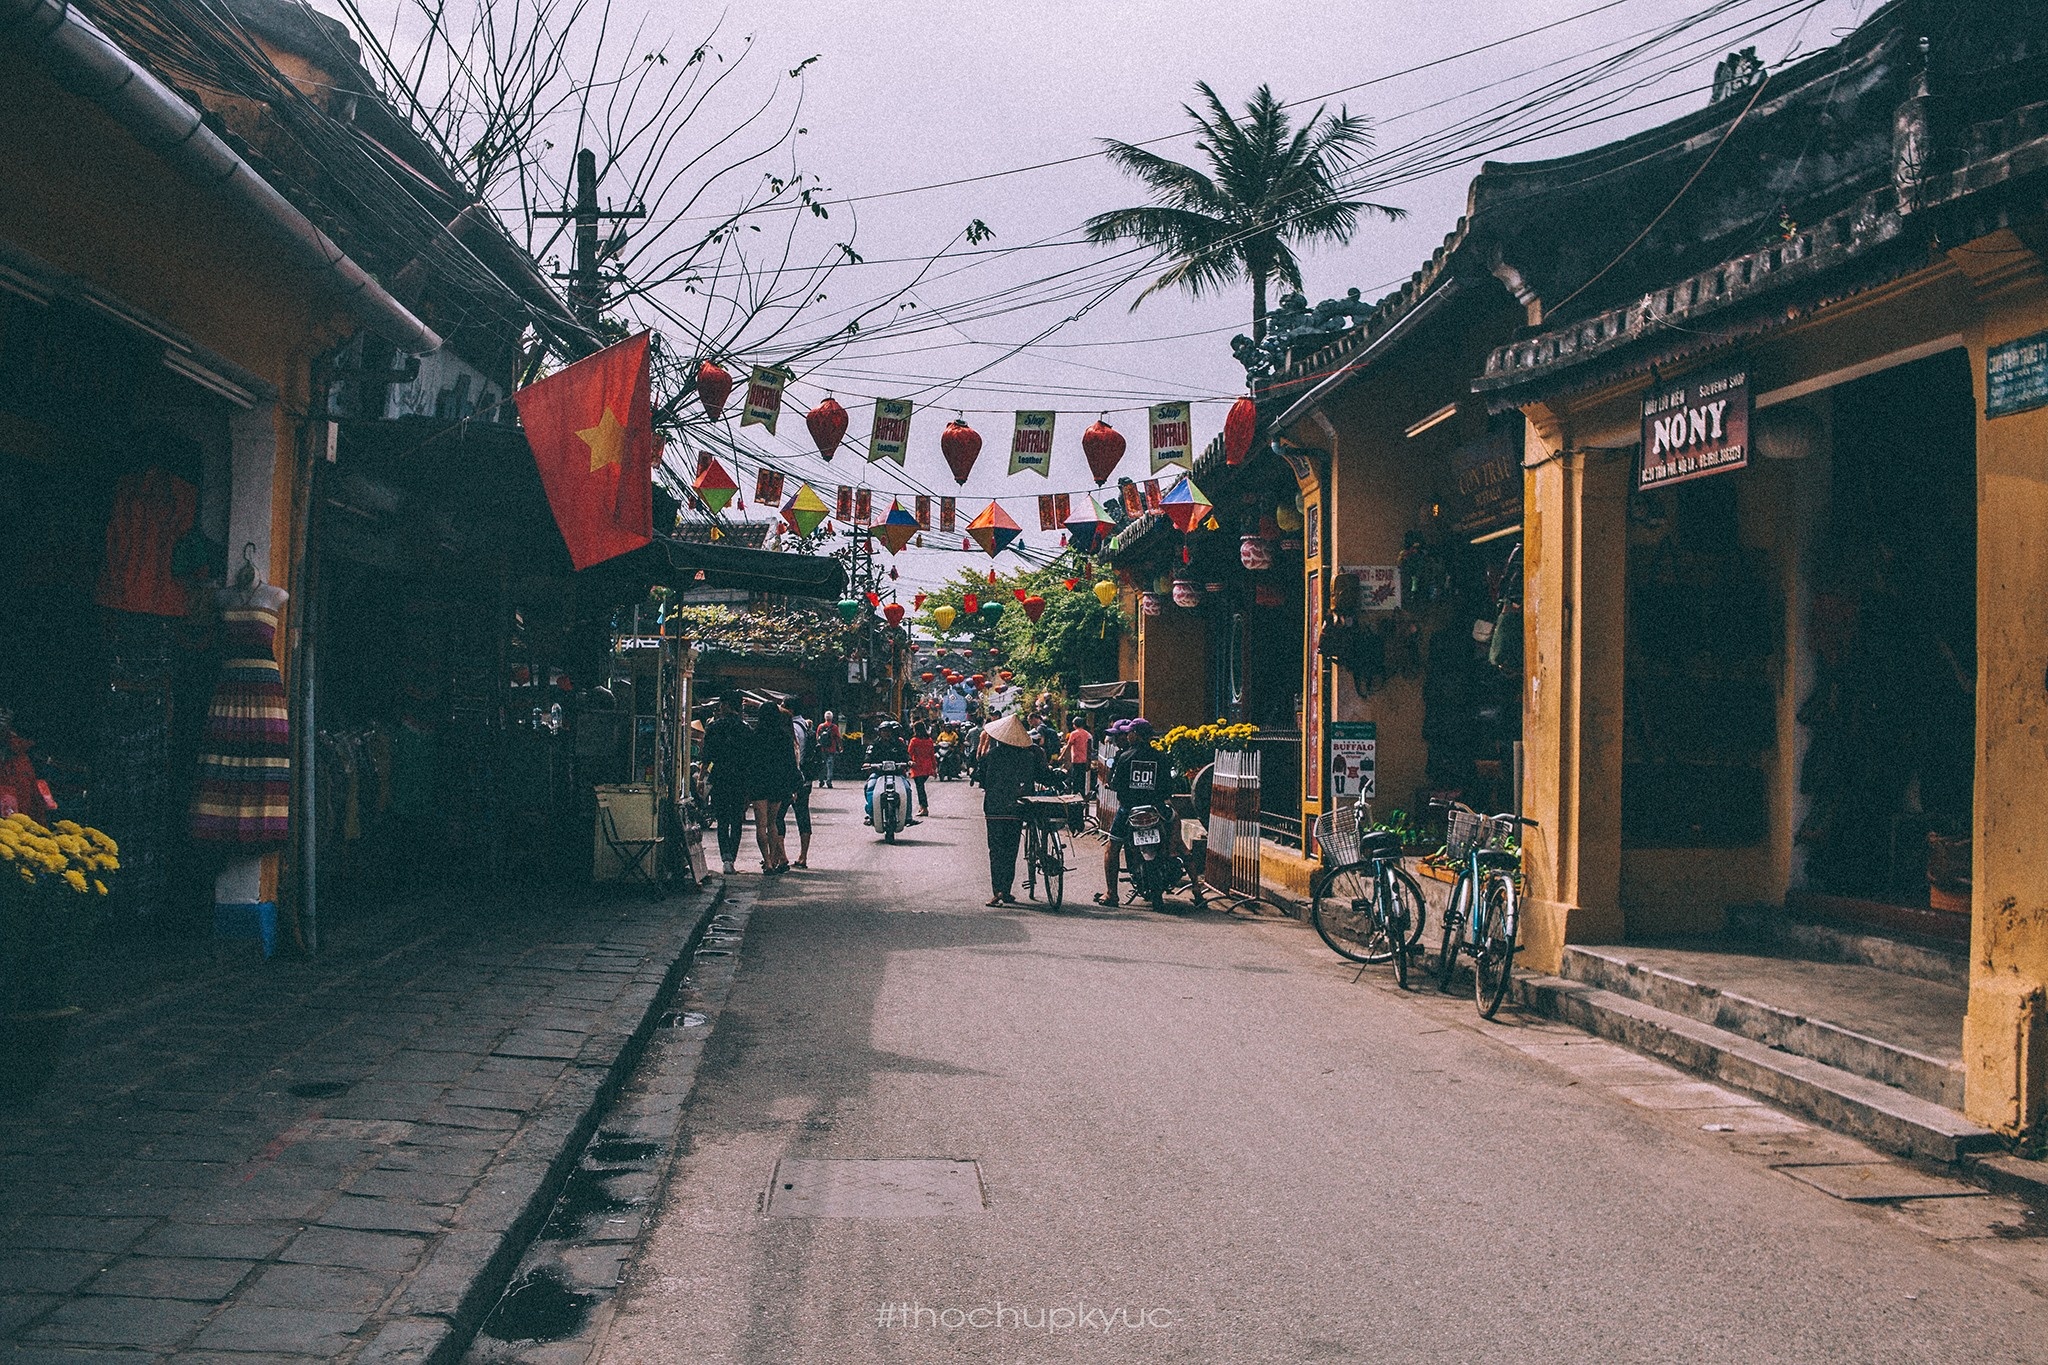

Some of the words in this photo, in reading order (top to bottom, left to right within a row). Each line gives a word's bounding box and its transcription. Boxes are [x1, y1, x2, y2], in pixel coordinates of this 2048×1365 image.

[749, 383, 781, 411] BUFFALO
[884, 402, 903, 416] Shop
[1158, 406, 1181, 420] Shop
[1024, 414, 1046, 427] Shop
[875, 416, 907, 443] BUFFALO
[1152, 421, 1189, 449] BUFFALO
[877, 443, 899, 453] Leather
[1015, 430, 1050, 454] BUFFALO
[1018, 456, 1043, 464] Leather
[1158, 450, 1184, 460] Leather
[1333, 743, 1374, 751] BUFFALO
[1132, 770, 1153, 785] GO!
